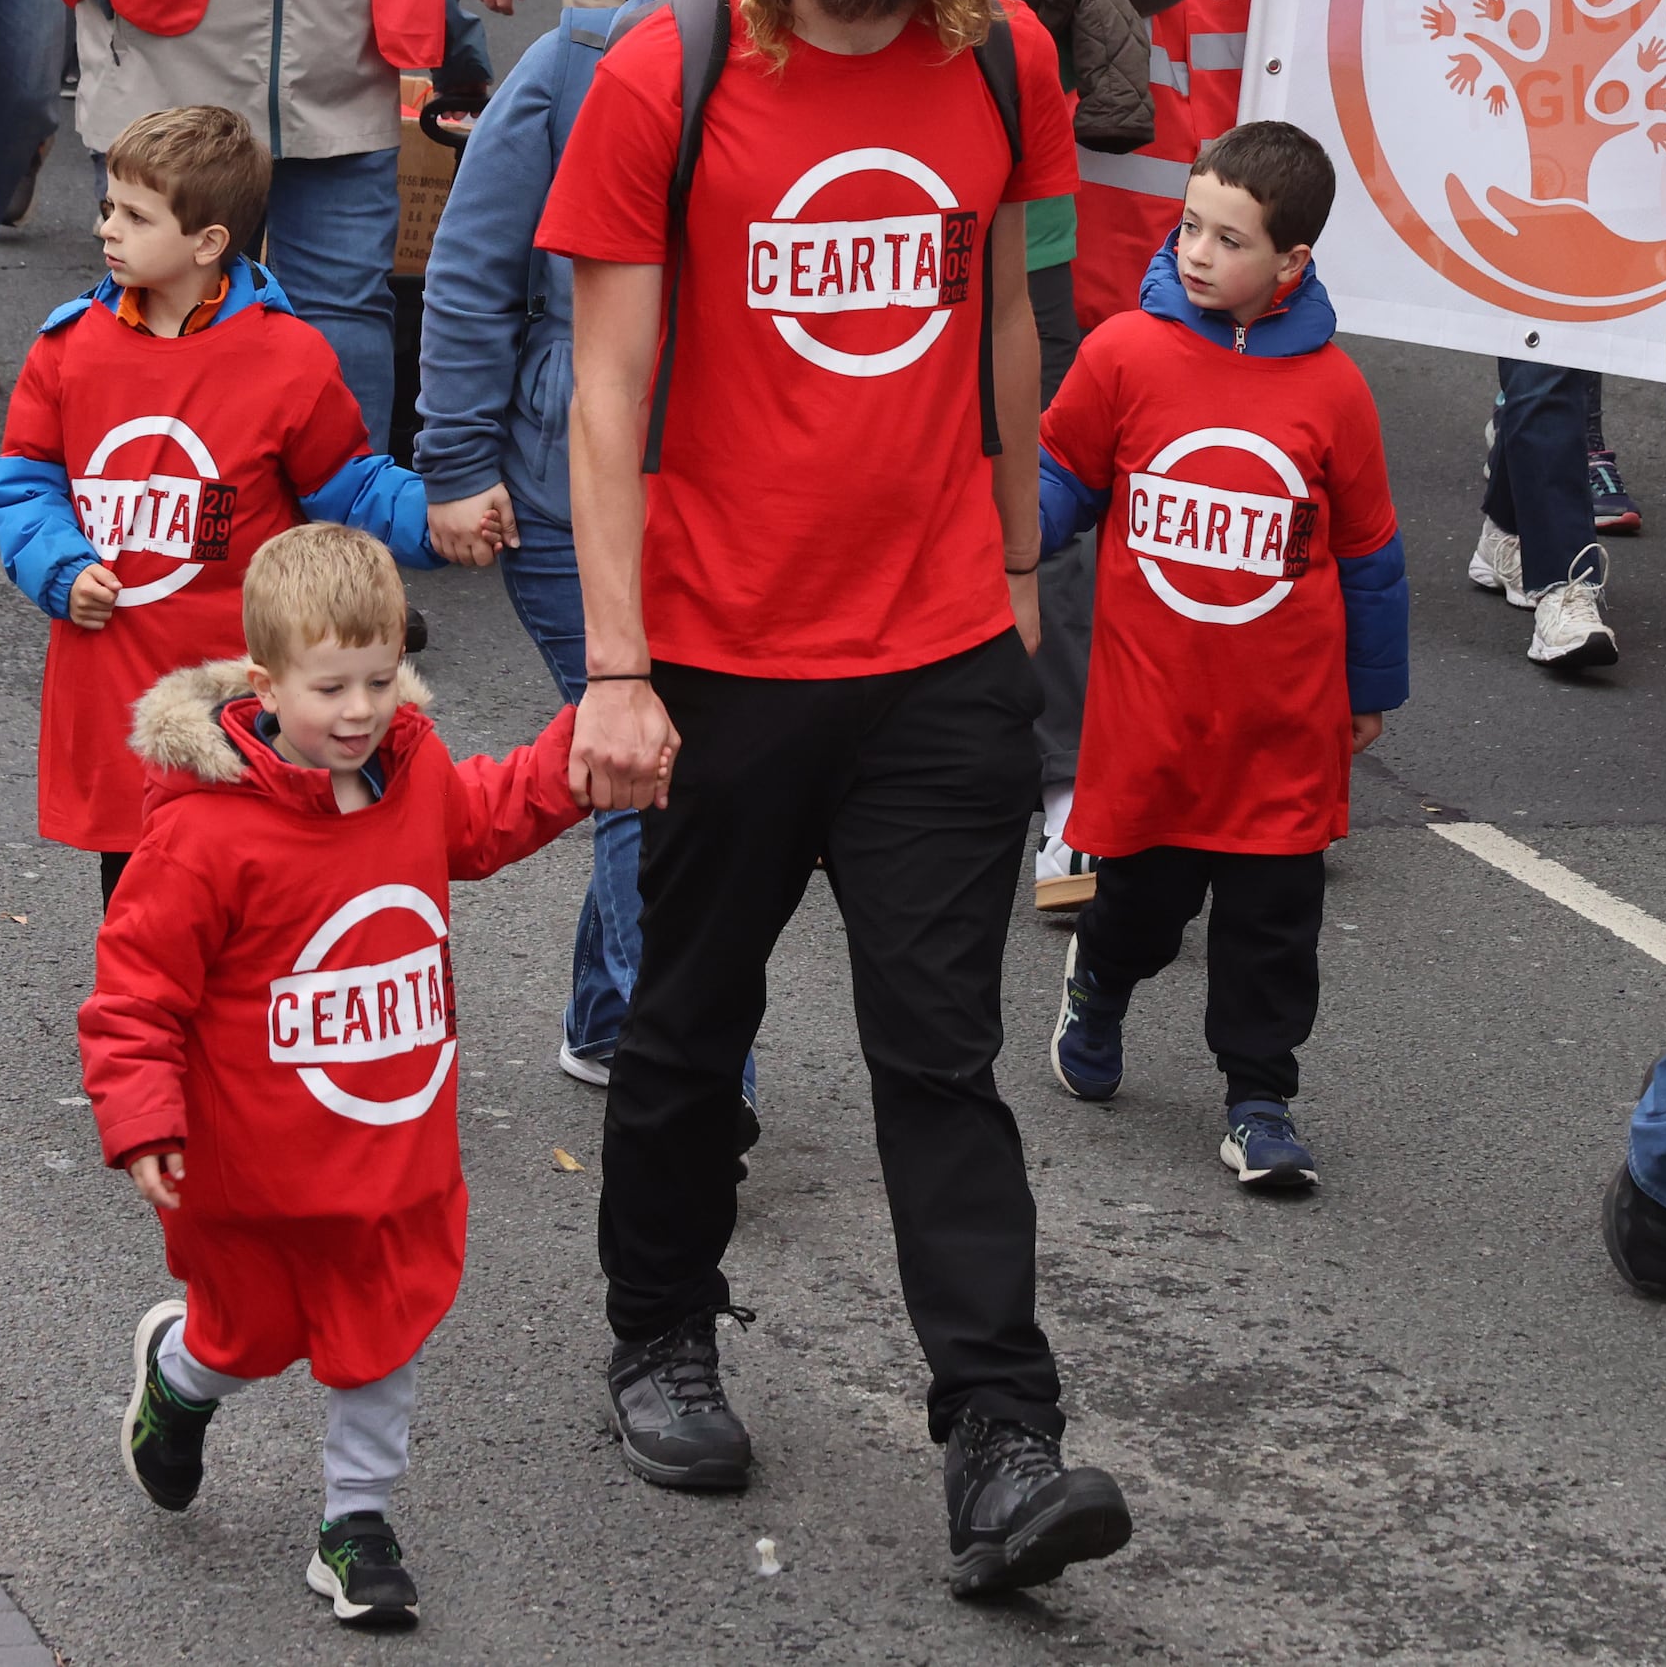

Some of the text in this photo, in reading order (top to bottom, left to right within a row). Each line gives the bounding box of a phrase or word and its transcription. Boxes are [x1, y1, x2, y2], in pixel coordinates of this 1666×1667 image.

[751, 218, 977, 298] CEARTA 20
[944, 252, 971, 278] 09
[77, 485, 235, 547] CEATA 20
[200, 518, 231, 542] 09
[1130, 487, 1285, 564] CEARTA
[196, 542, 230, 559] 2025
[272, 967, 445, 1048] CEARTA
